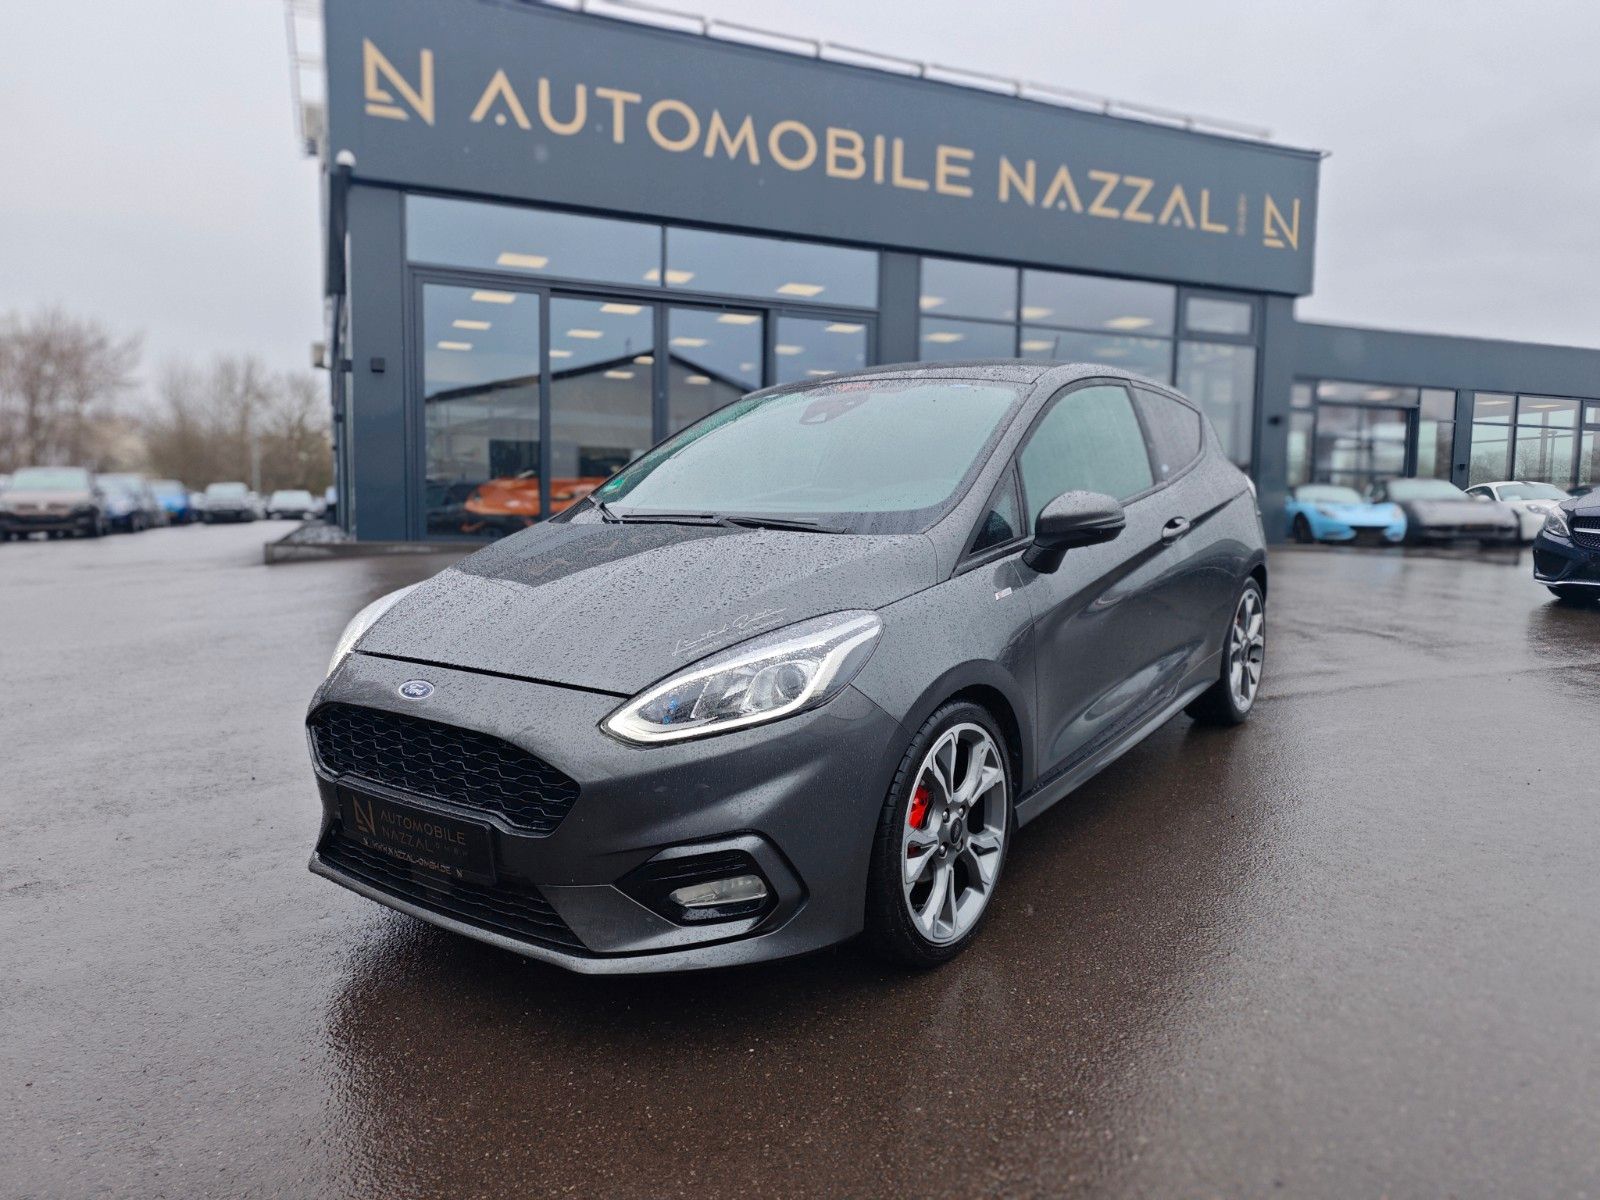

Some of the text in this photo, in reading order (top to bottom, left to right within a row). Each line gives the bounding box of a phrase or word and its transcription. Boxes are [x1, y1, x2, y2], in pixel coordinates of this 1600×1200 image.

[470, 68, 975, 197] AUTOMOBILE
[998, 155, 1229, 235] NAZZAL
[380, 809, 467, 846] AUTOMOBILE
[381, 825, 434, 852] NAZZAL
